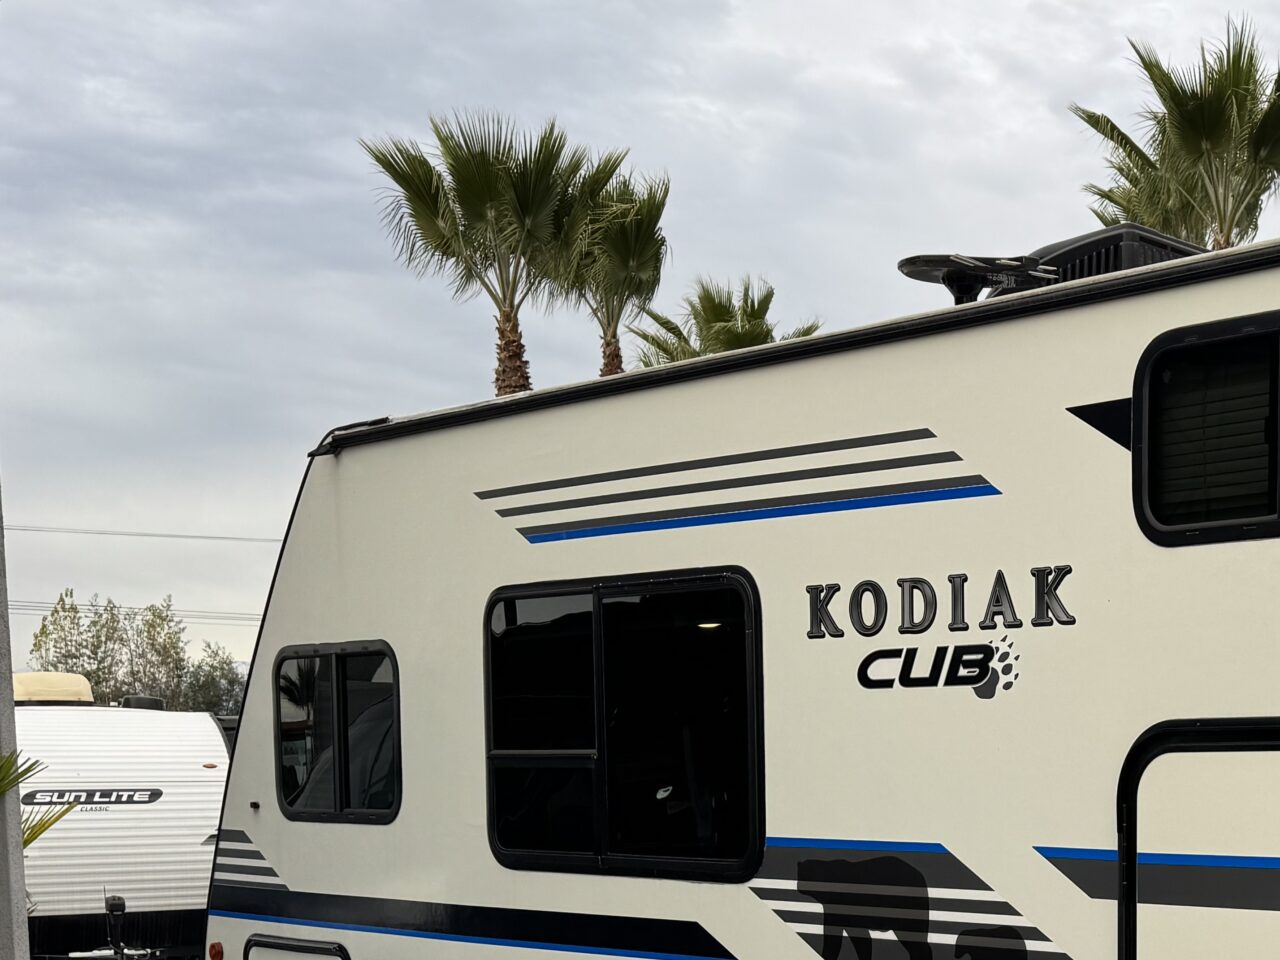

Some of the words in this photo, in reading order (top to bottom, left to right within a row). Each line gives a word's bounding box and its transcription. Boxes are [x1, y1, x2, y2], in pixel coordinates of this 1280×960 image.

[806, 564, 1077, 640] KODIAK
[856, 643, 997, 690] CUB
[33, 791, 87, 803] SUN
[93, 791, 151, 802] LITE
